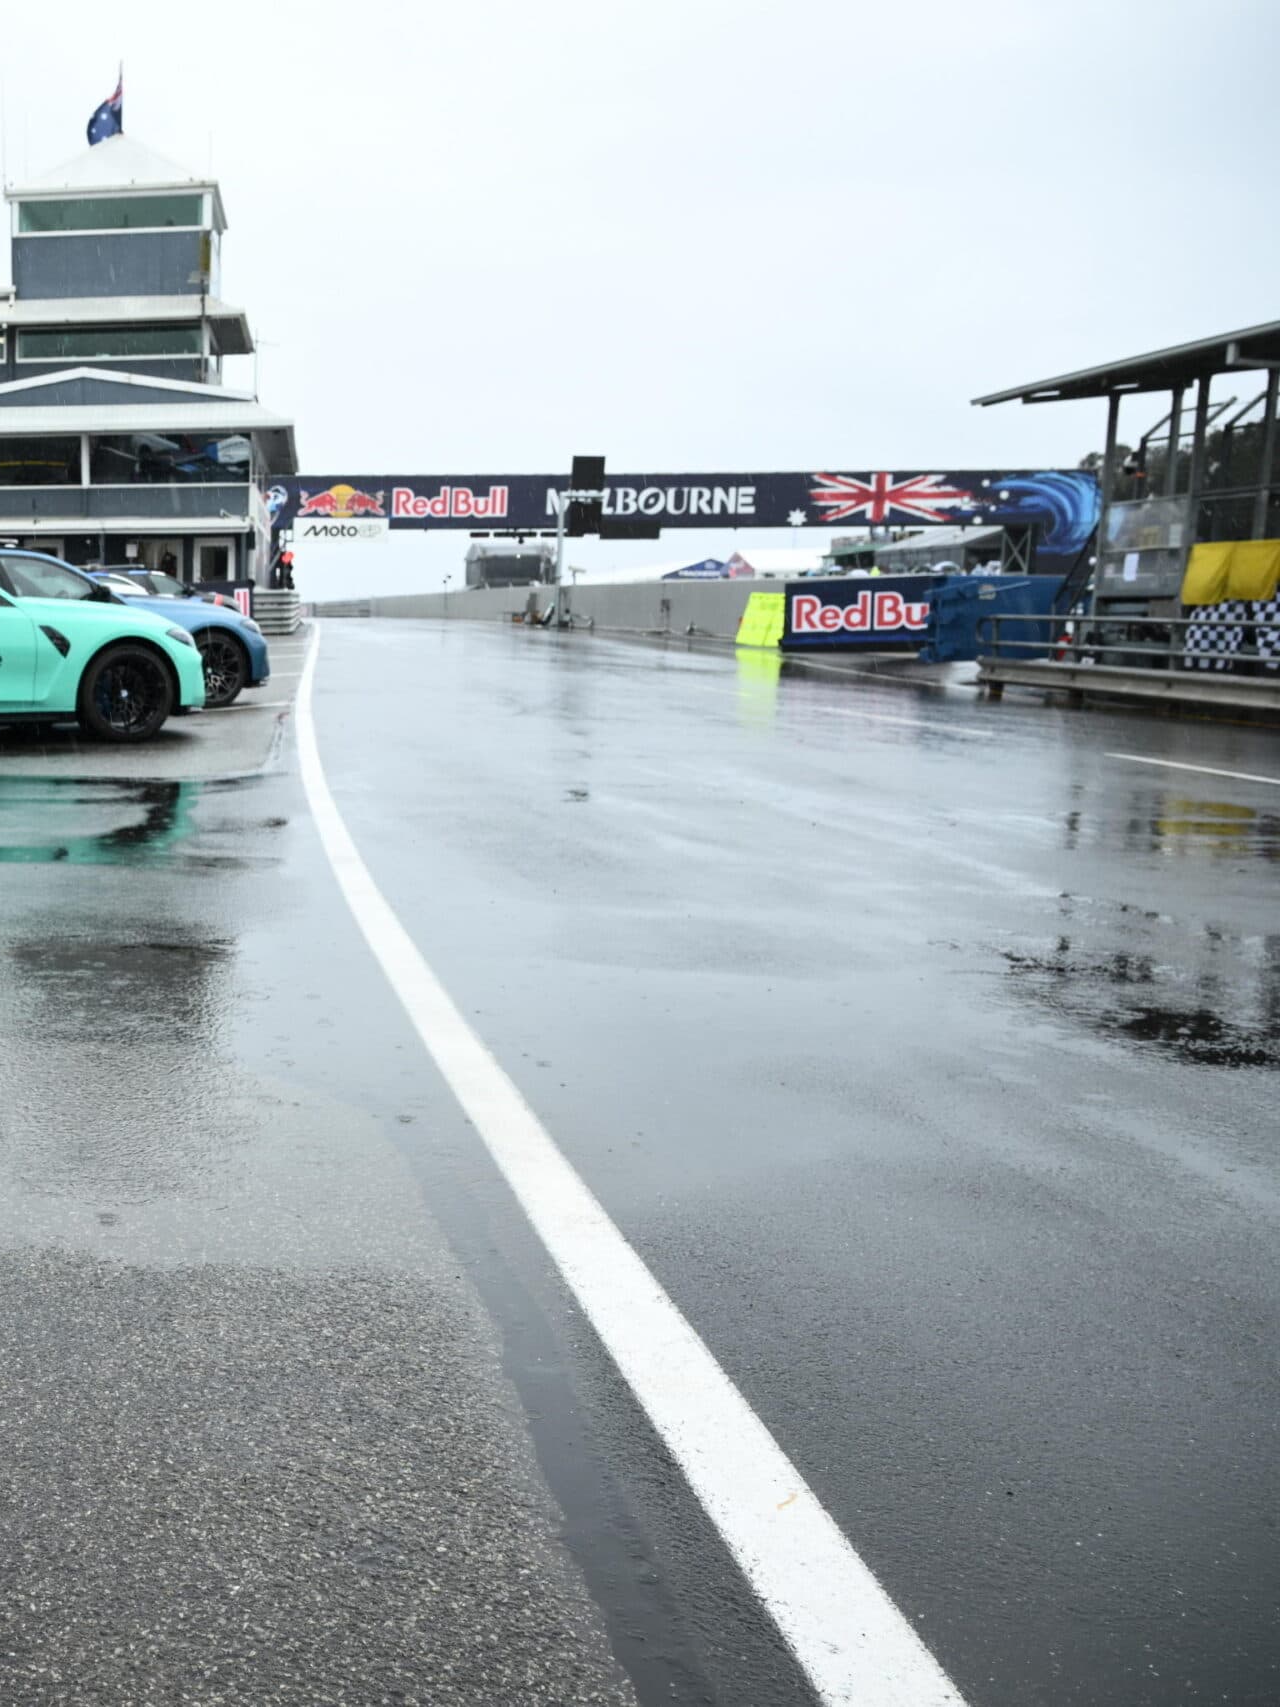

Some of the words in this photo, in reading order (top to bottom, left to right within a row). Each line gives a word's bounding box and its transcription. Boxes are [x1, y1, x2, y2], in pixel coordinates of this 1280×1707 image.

[392, 486, 450, 517] Red
[451, 486, 508, 517] Bull
[545, 486, 756, 515] MLBOURNE
[792, 591, 872, 633] Red
[873, 591, 930, 630] Bu
